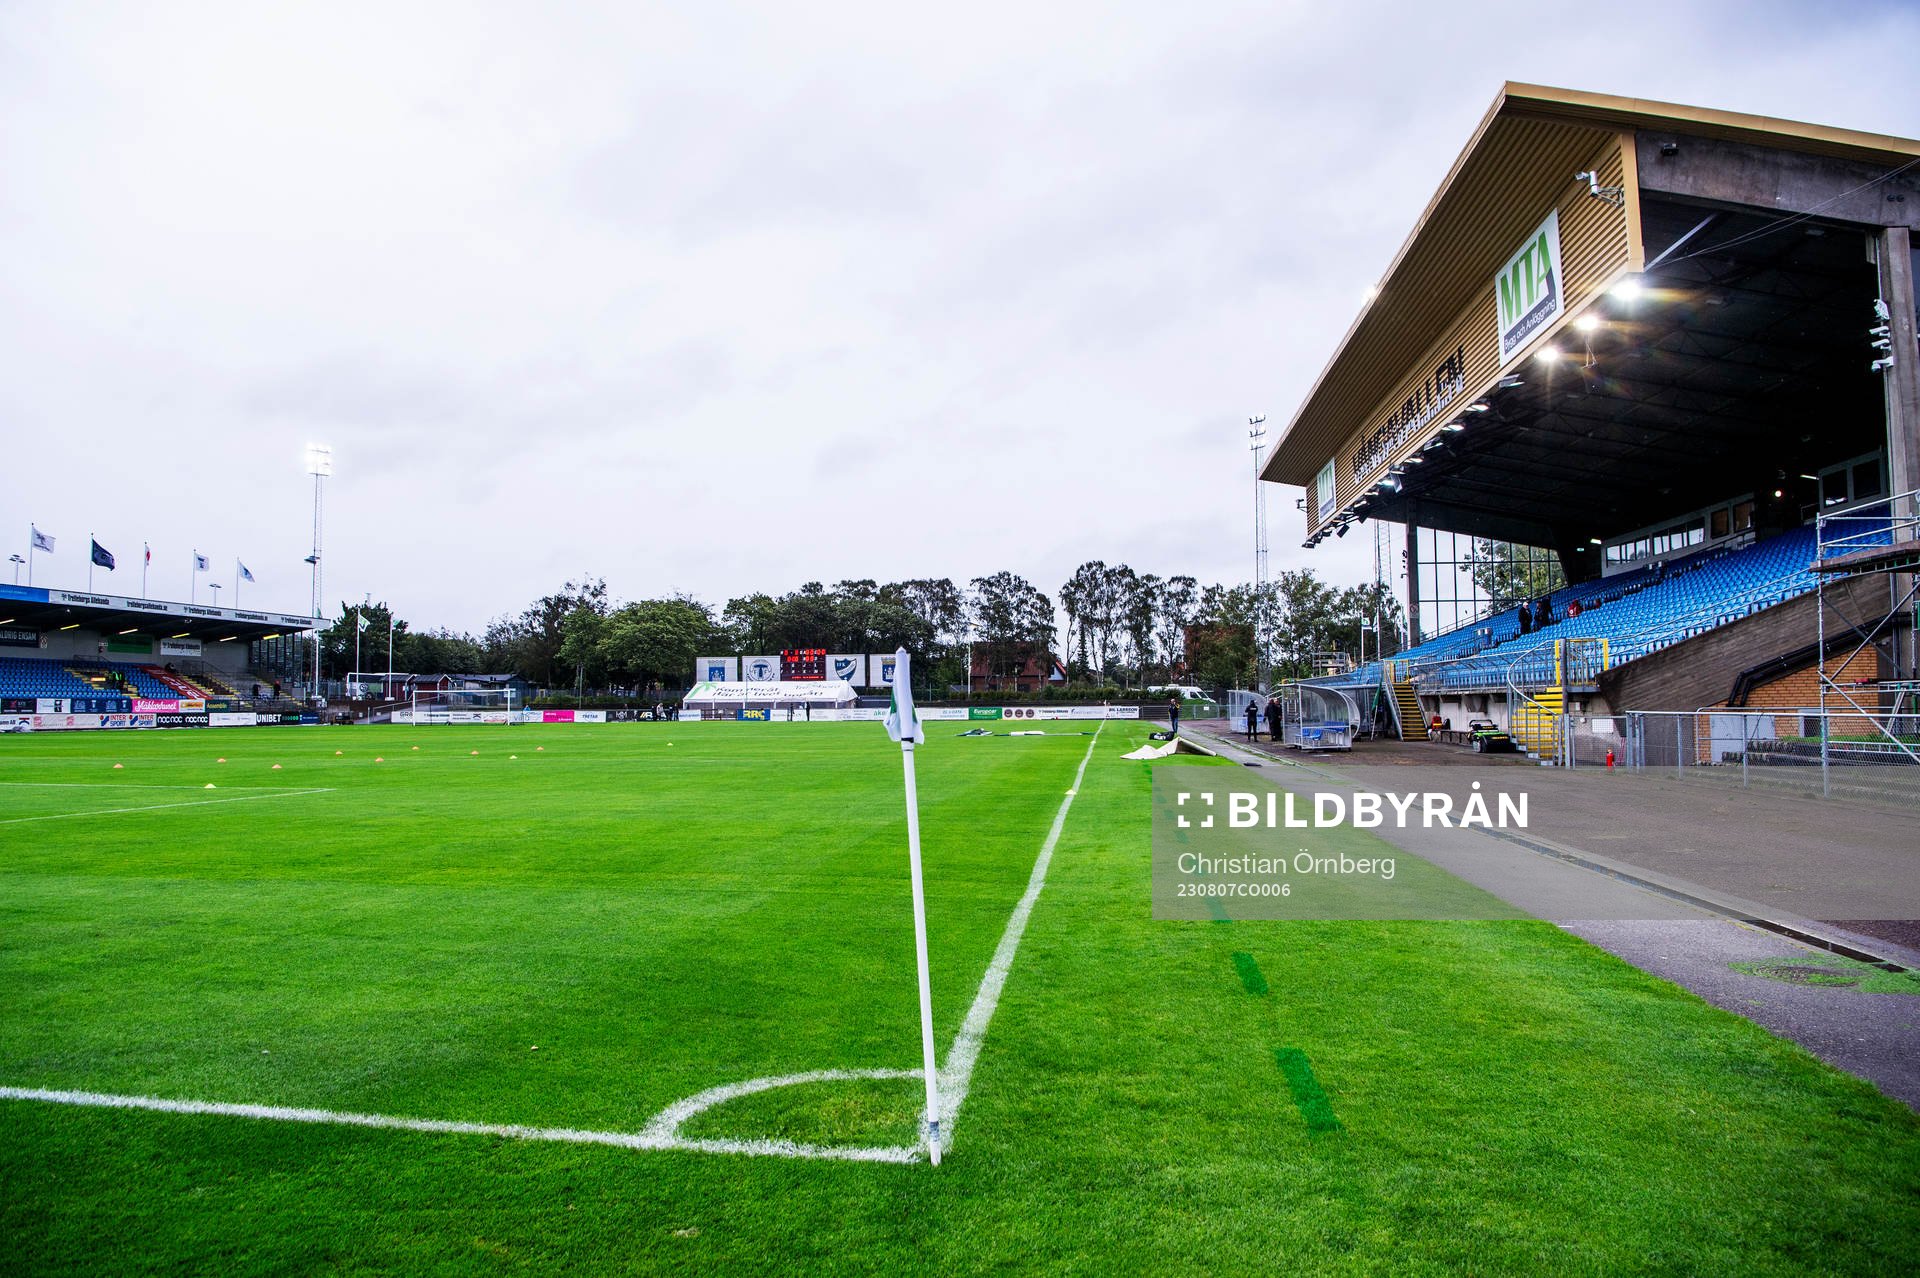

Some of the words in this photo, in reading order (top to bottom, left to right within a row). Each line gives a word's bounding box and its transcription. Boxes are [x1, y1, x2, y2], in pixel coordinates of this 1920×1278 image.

[1501, 231, 1552, 330] MTA
[1504, 333, 1517, 350] Bygg
[1516, 323, 1526, 340] och
[1526, 299, 1556, 331] Anläggning
[18, 631, 37, 640] ENSAM
[134, 700, 177, 711] Mäklarhuset
[256, 714, 281, 722] UNIBET
